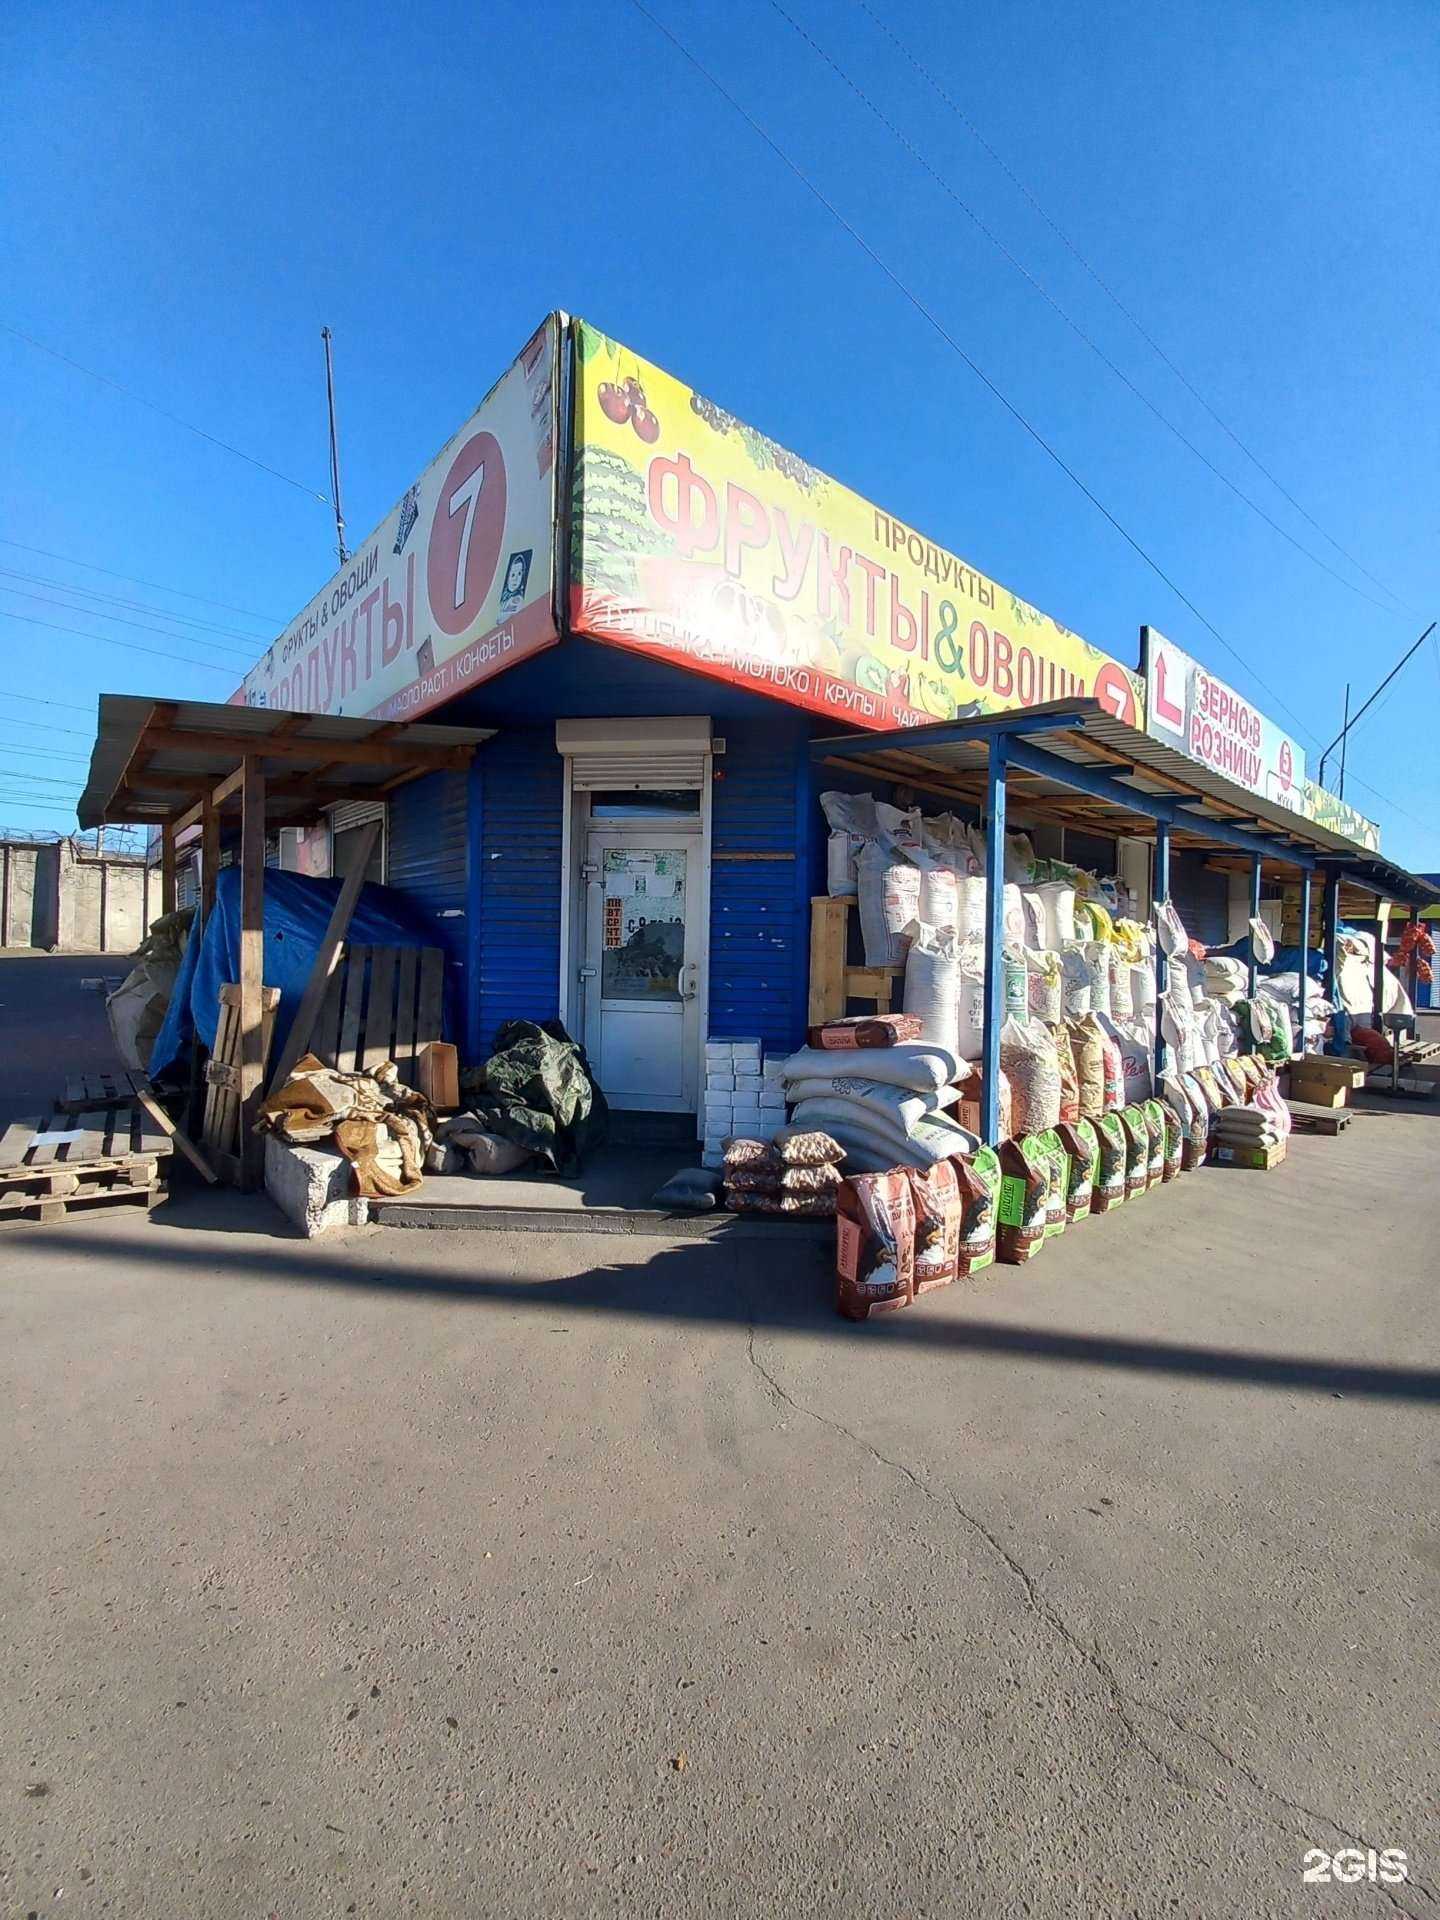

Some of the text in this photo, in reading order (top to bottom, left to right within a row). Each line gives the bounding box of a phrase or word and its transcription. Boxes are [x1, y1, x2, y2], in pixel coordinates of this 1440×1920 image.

[449, 461, 486, 609] 7
[648, 451, 929, 661] ФРУКТЫ
[934, 600, 965, 679] &
[874, 510, 995, 610] ПРОДУКТЫ
[331, 544, 379, 616] ОВОЩИ
[456, 623, 515, 680] КОНФЕТЫ
[731, 650, 809, 693] МОЛОКО
[825, 680, 876, 717] КРУПЫ
[892, 706, 920, 727] ЧАЙ
[1200, 676, 1261, 748] ЗЕРНО В
[1191, 714, 1262, 788] РОЗНИЦУ
[607, 918, 620, 927] СР
